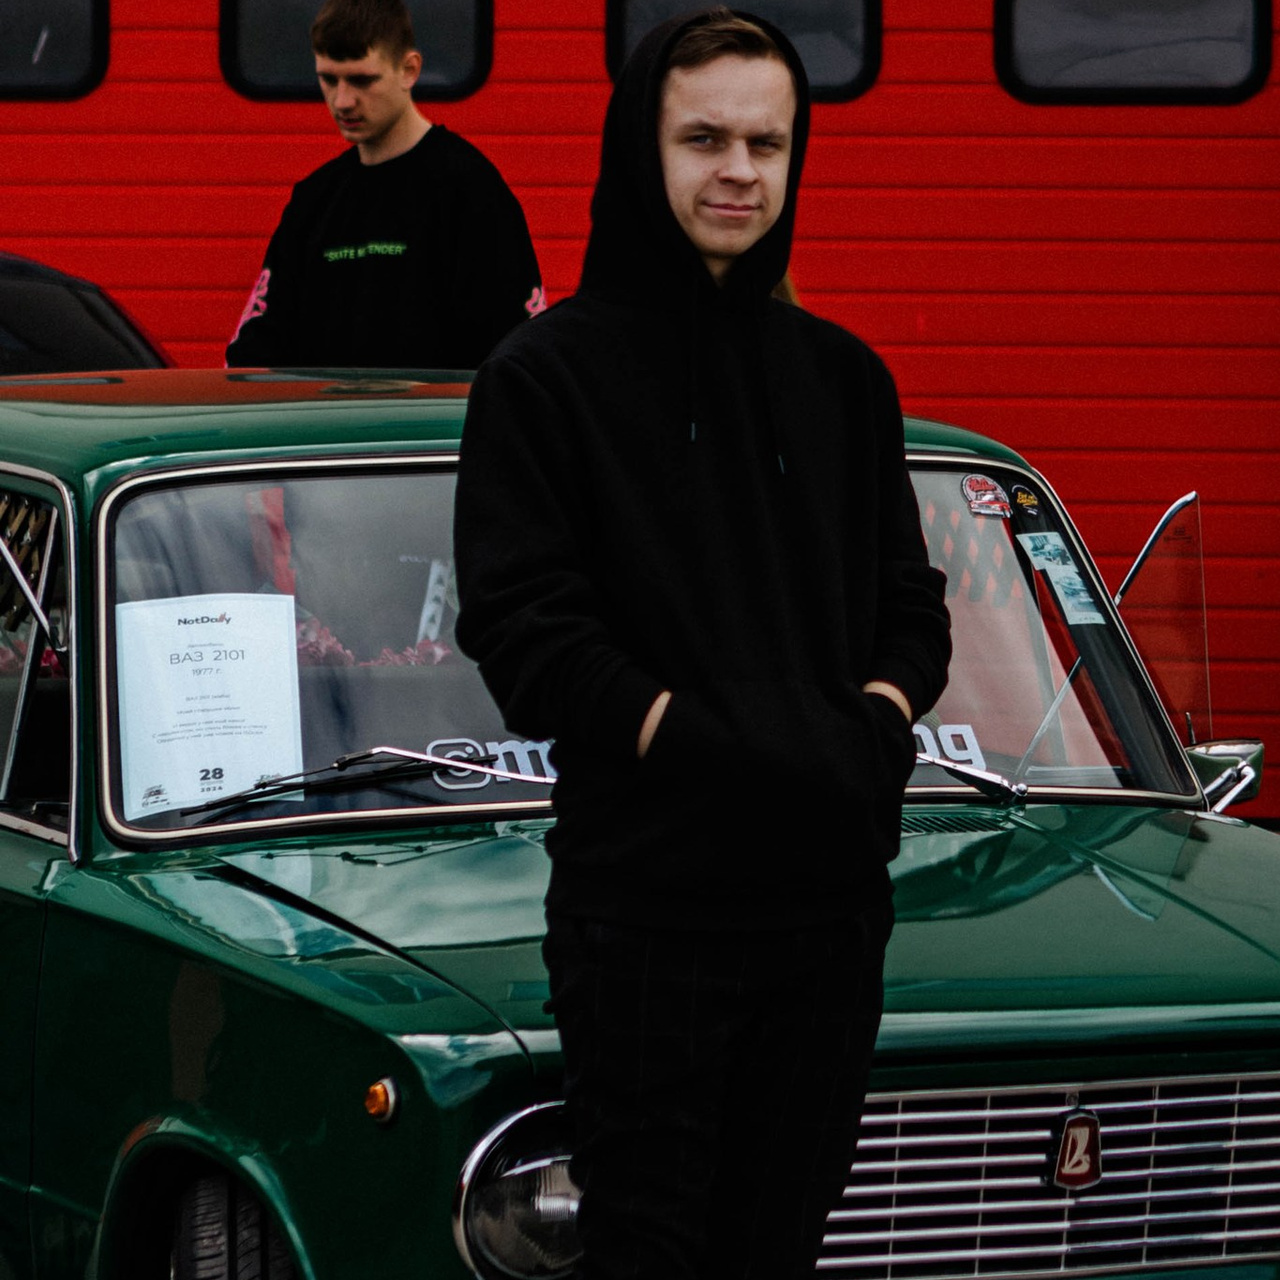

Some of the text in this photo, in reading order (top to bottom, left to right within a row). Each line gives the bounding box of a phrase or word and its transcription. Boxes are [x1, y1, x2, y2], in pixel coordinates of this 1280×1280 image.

[169, 649, 246, 665] ВАЗ 2101
[191, 668, 214, 677] 1977
[199, 767, 225, 782] 28
